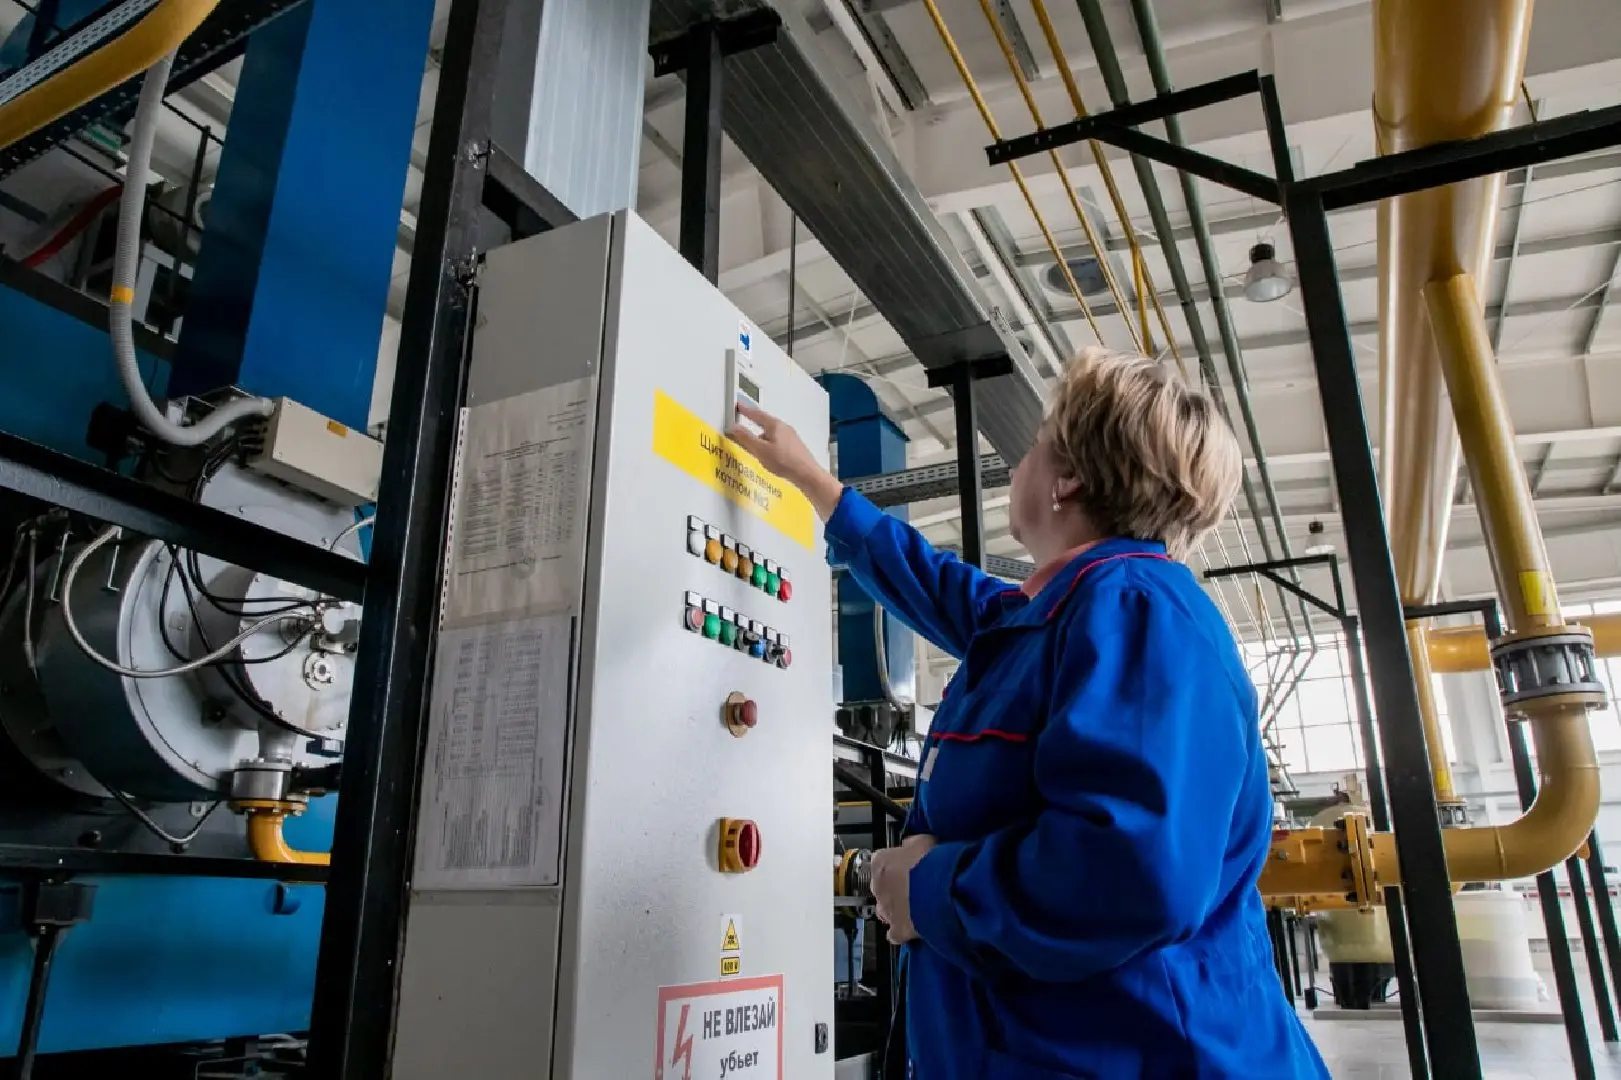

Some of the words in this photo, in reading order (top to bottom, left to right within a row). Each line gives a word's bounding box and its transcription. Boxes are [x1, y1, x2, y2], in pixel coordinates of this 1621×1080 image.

[700, 432, 724, 460] Щит
[725, 452, 783, 500] управления
[715, 467, 750, 500] котлом
[703, 1009, 721, 1040] НЕ
[725, 996, 776, 1035] ВЛЕЗАЙ
[719, 1050, 759, 1078] убьет
